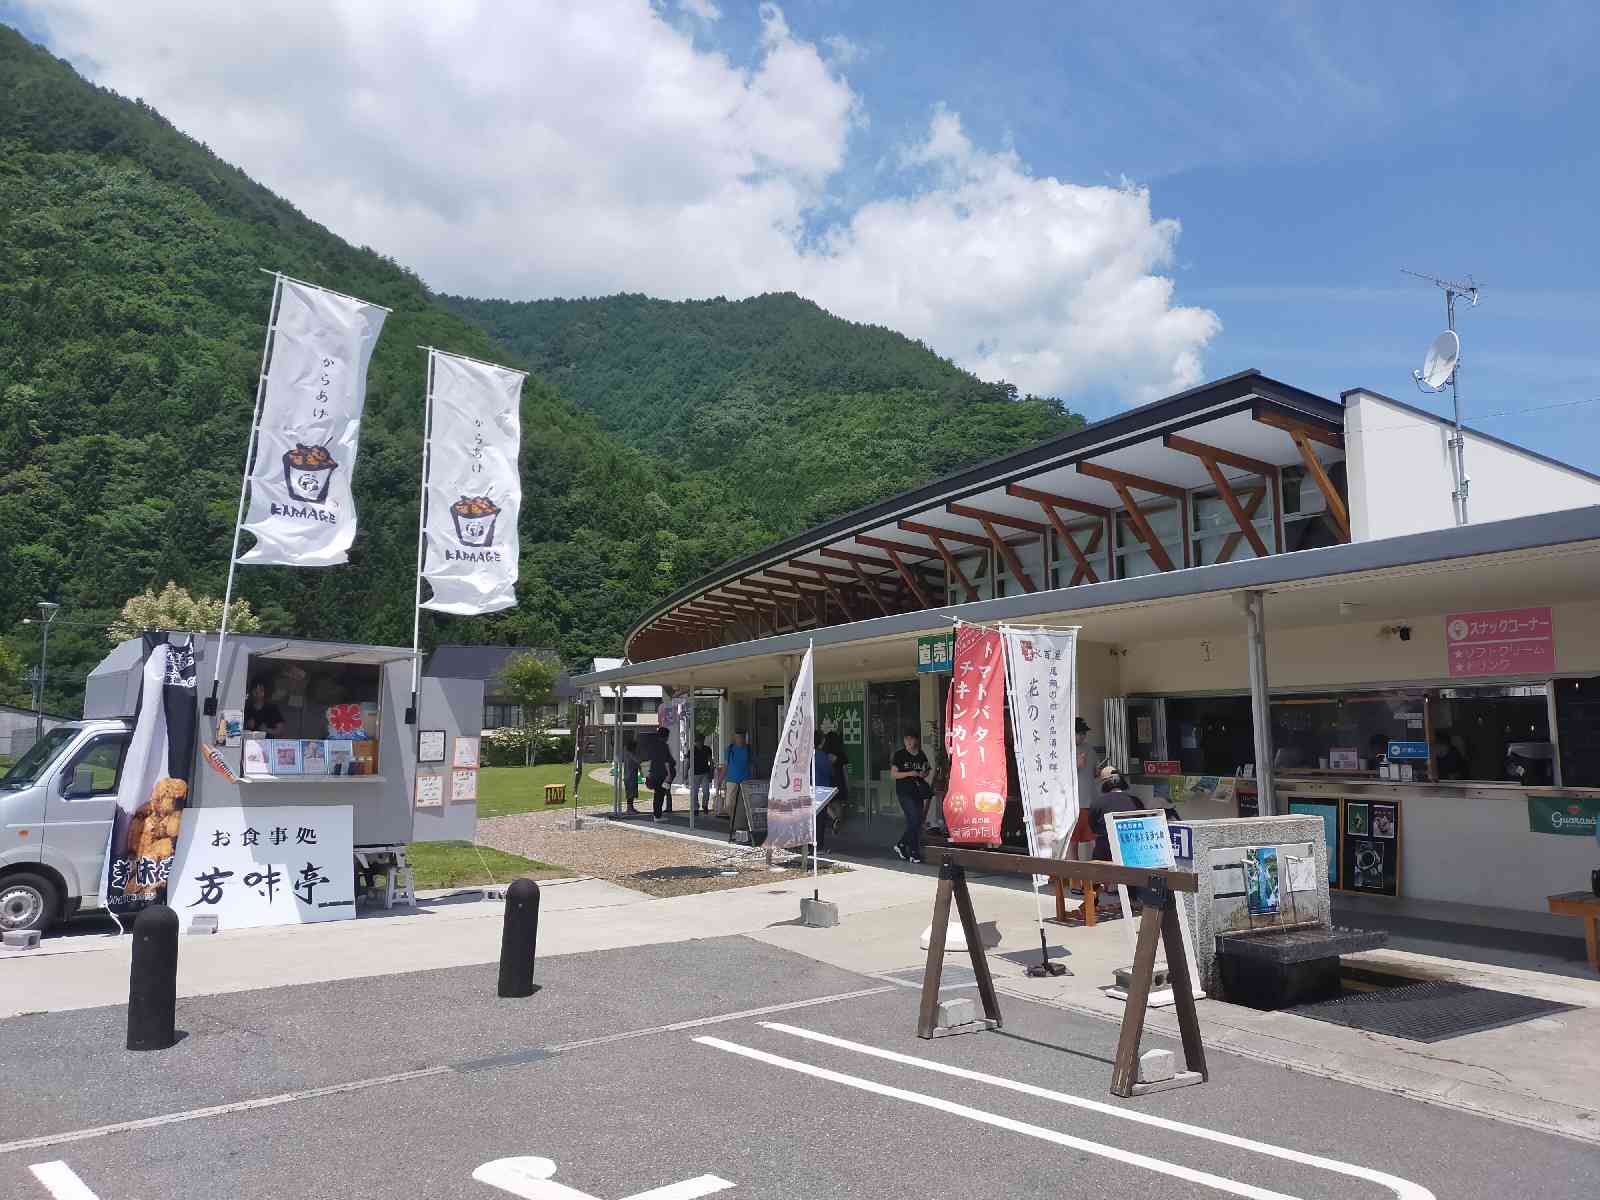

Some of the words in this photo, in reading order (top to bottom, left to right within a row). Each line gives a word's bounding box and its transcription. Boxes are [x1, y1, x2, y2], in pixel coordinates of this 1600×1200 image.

[314, 358, 334, 419] からあげ
[270, 502, 337, 525] KARAAGE
[445, 548, 503, 563] KARAAGE
[1470, 617, 1550, 635] スナックコーナー
[972, 640, 992, 763] トマトバター
[953, 660, 974, 779] チキンカレー
[211, 826, 318, 847] お食事処
[185, 861, 331, 908] 芳味亭
